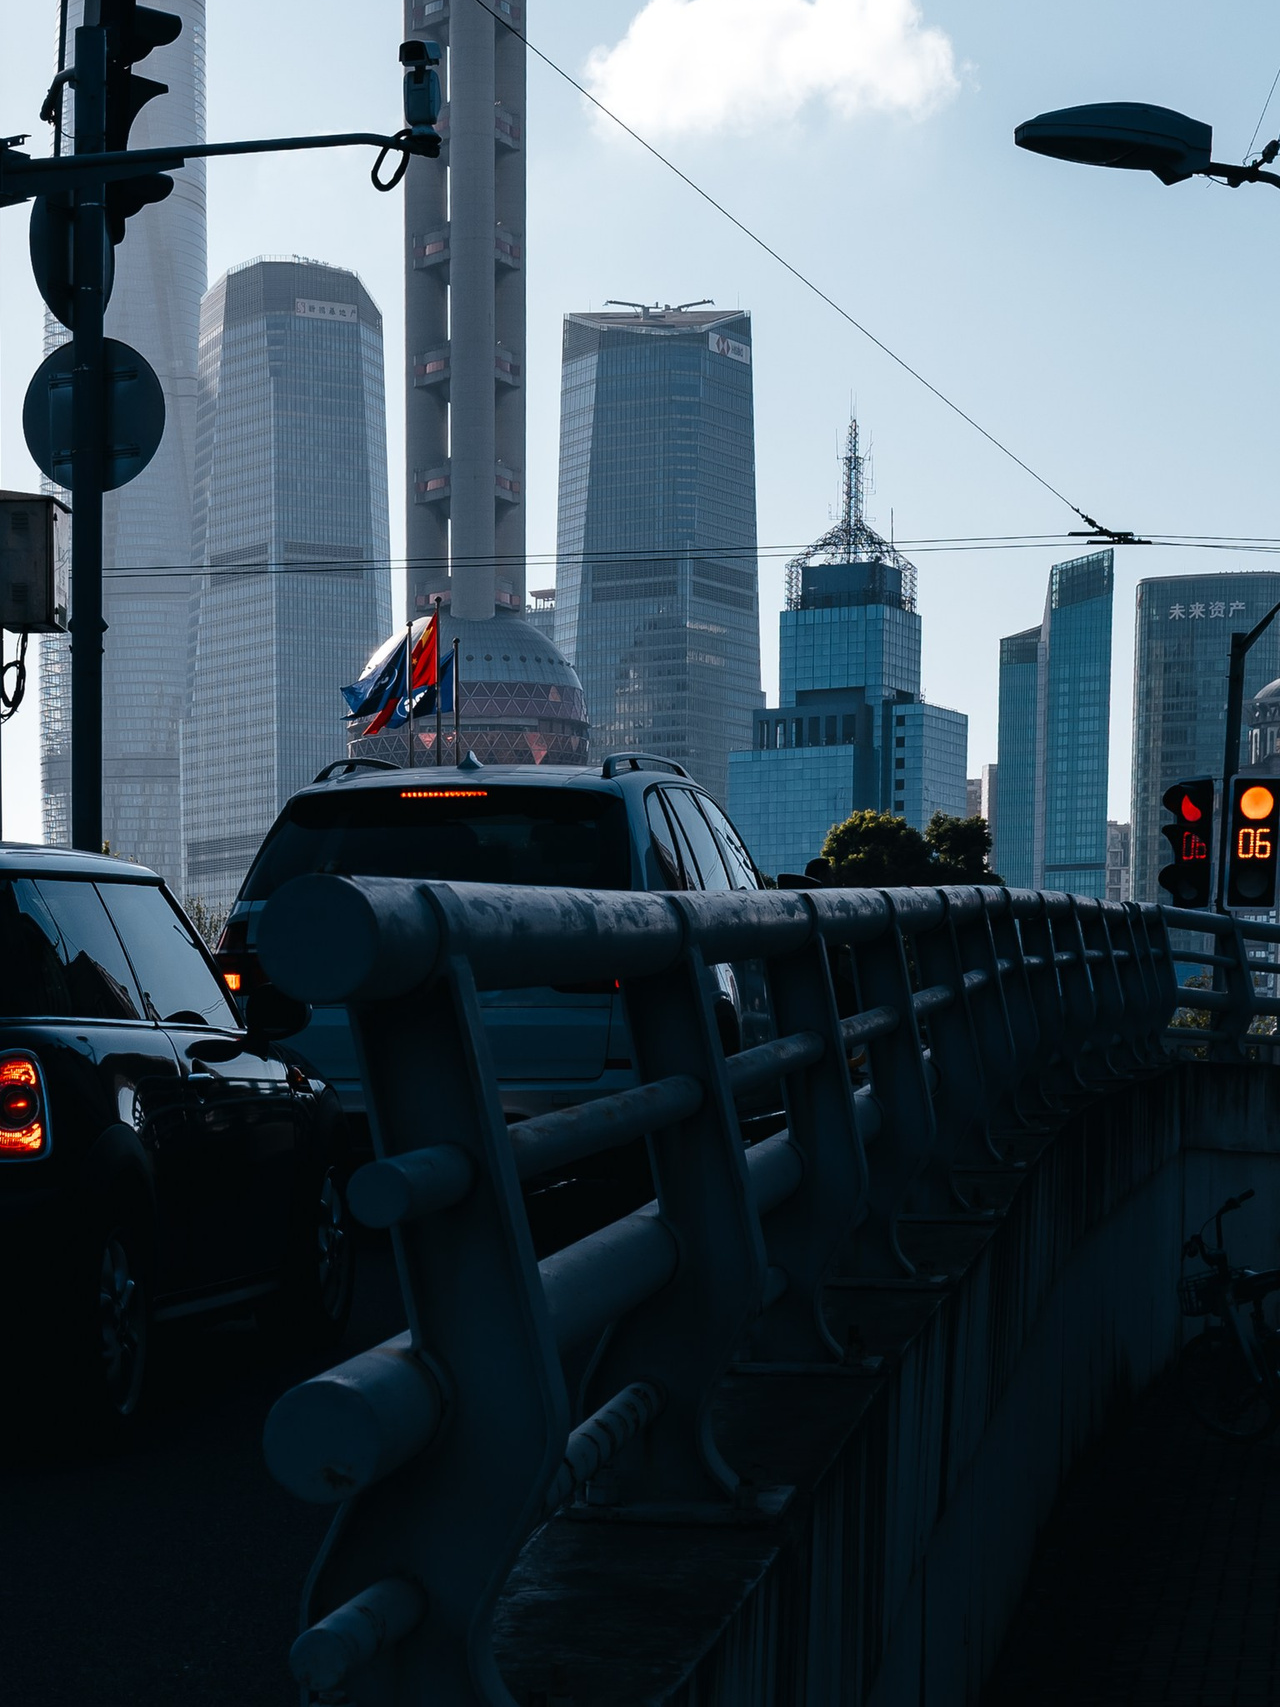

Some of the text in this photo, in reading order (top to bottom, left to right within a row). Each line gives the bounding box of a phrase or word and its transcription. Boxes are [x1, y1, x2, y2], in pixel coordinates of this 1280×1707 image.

[1168, 600, 1246, 620] 未来资产
[1238, 828, 1271, 859] 06
